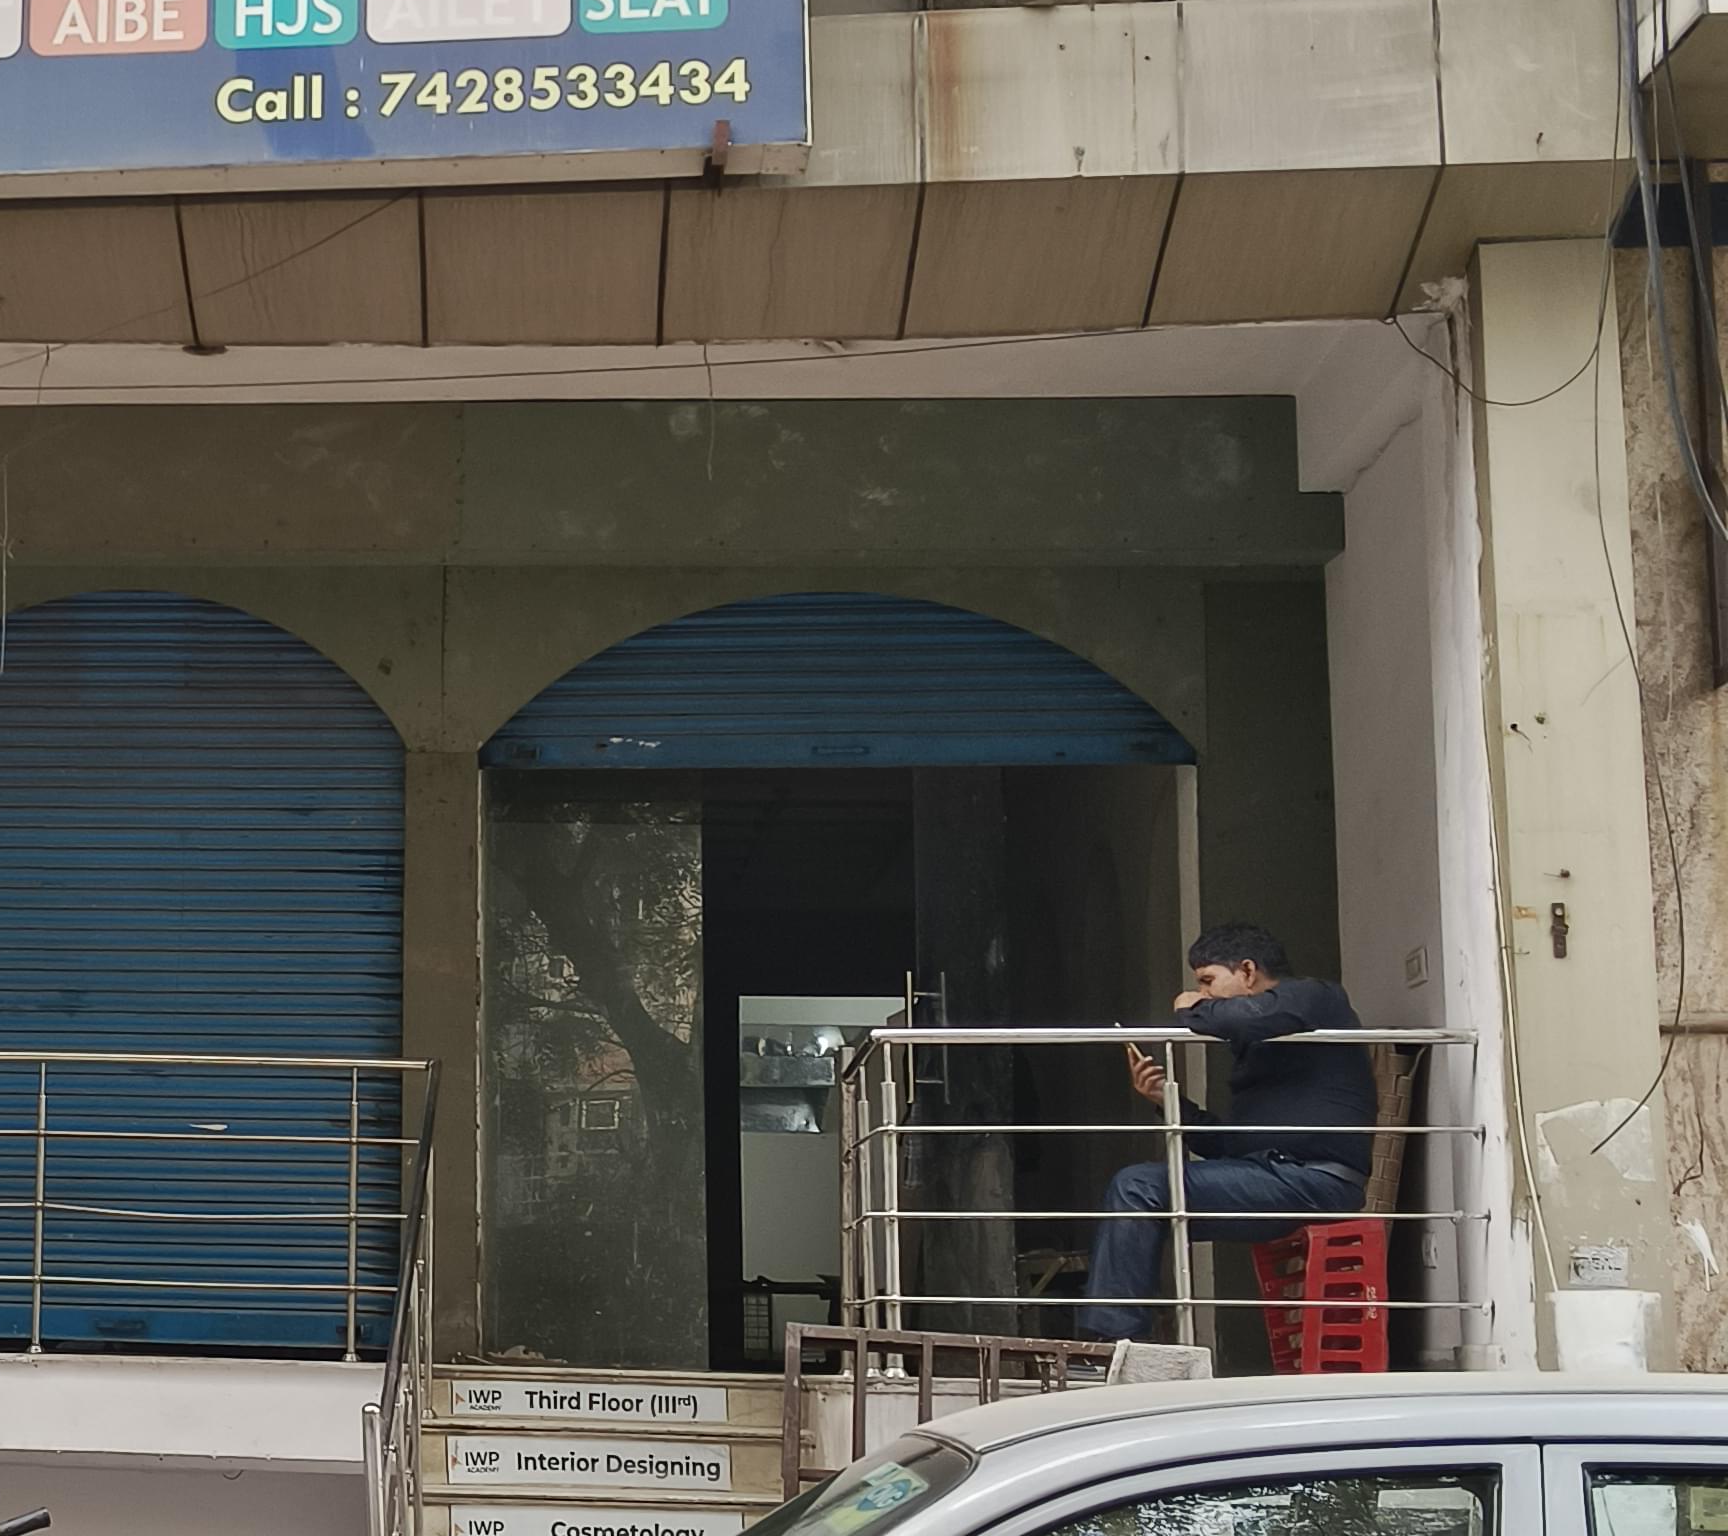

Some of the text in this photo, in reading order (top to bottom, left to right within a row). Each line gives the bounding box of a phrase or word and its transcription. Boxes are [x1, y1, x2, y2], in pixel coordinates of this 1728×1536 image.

[215, 74, 323, 125] Call
[378, 57, 751, 119] 7428533434
[468, 1390, 502, 1404] IWP
[525, 1390, 581, 1411] Third
[588, 1393, 644, 1413] Floor
[464, 1451, 721, 1482] IWP Interior Designing
[468, 1520, 505, 1536] IWP
